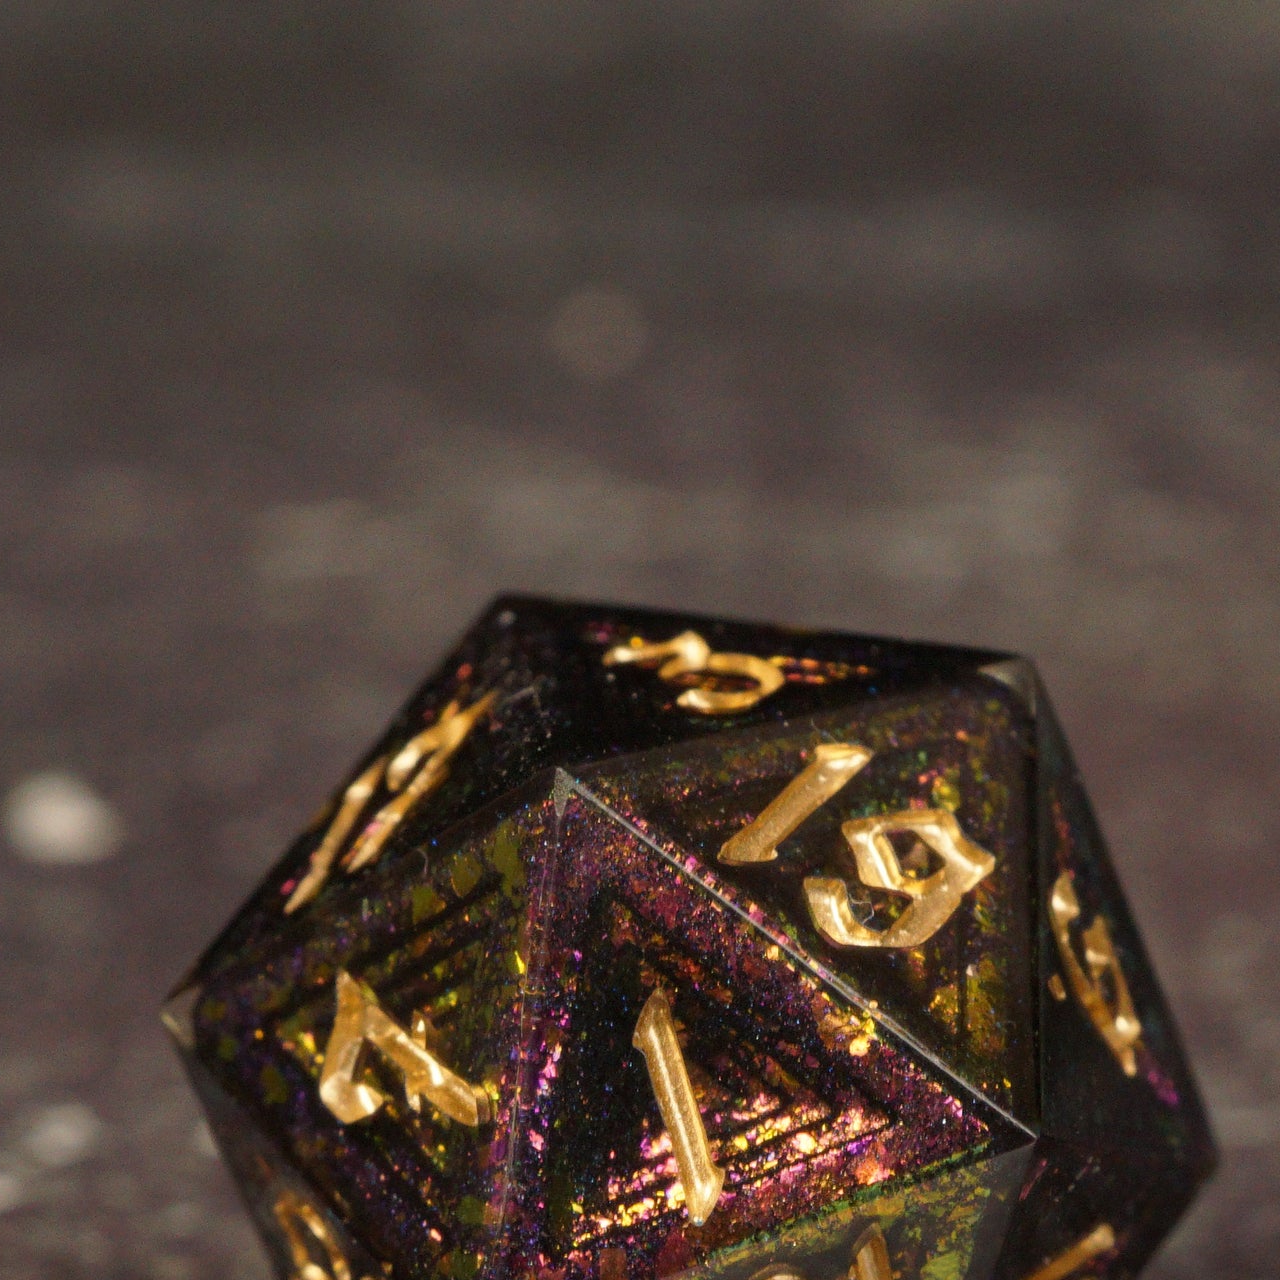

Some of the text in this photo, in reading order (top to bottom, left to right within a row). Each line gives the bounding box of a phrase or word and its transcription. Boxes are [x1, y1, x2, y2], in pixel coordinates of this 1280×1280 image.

[602, 628, 786, 714] 3
[718, 742, 995, 948] 19
[632, 986, 724, 1226] 1
